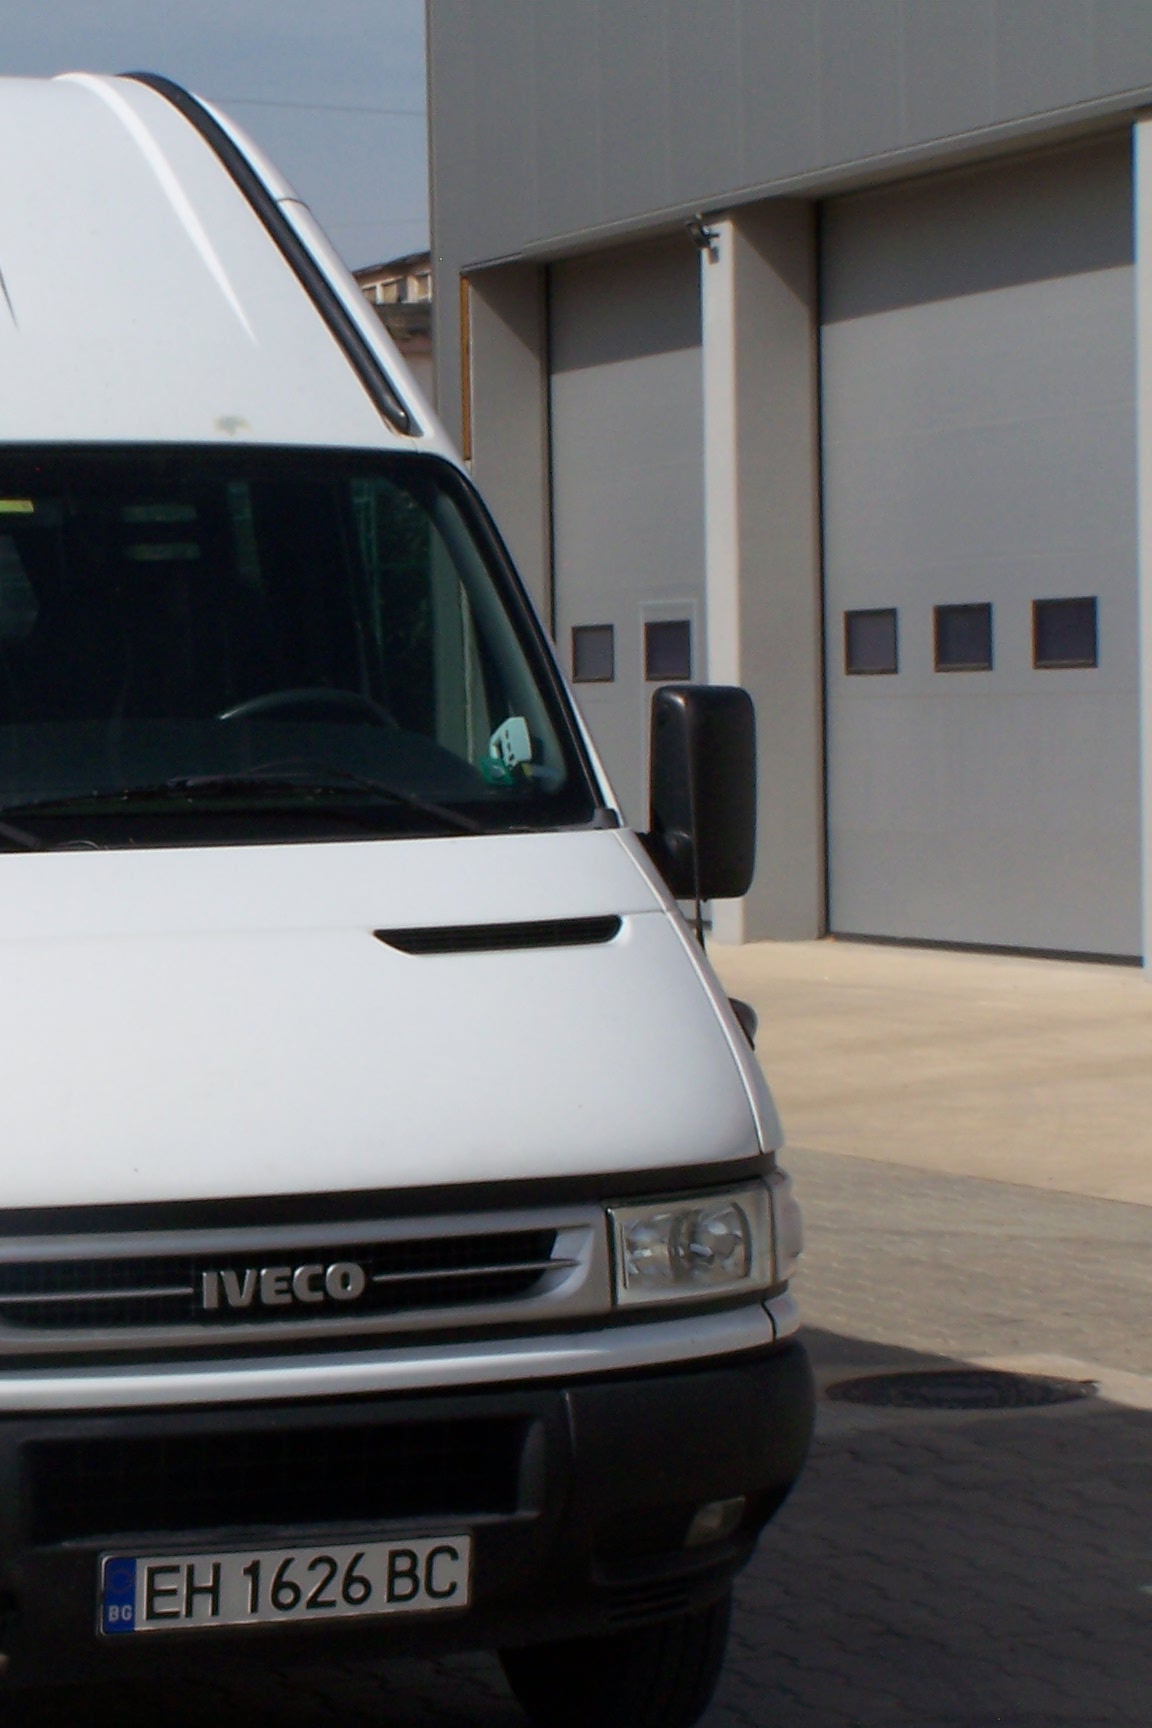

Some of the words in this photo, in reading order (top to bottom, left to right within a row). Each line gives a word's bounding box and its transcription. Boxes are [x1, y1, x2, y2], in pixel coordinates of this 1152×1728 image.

[202, 1262, 366, 1309] IVECO
[146, 1562, 221, 1620] EH
[243, 1552, 372, 1613] 1626
[384, 1545, 459, 1603] BC
[108, 1605, 133, 1622] BG
